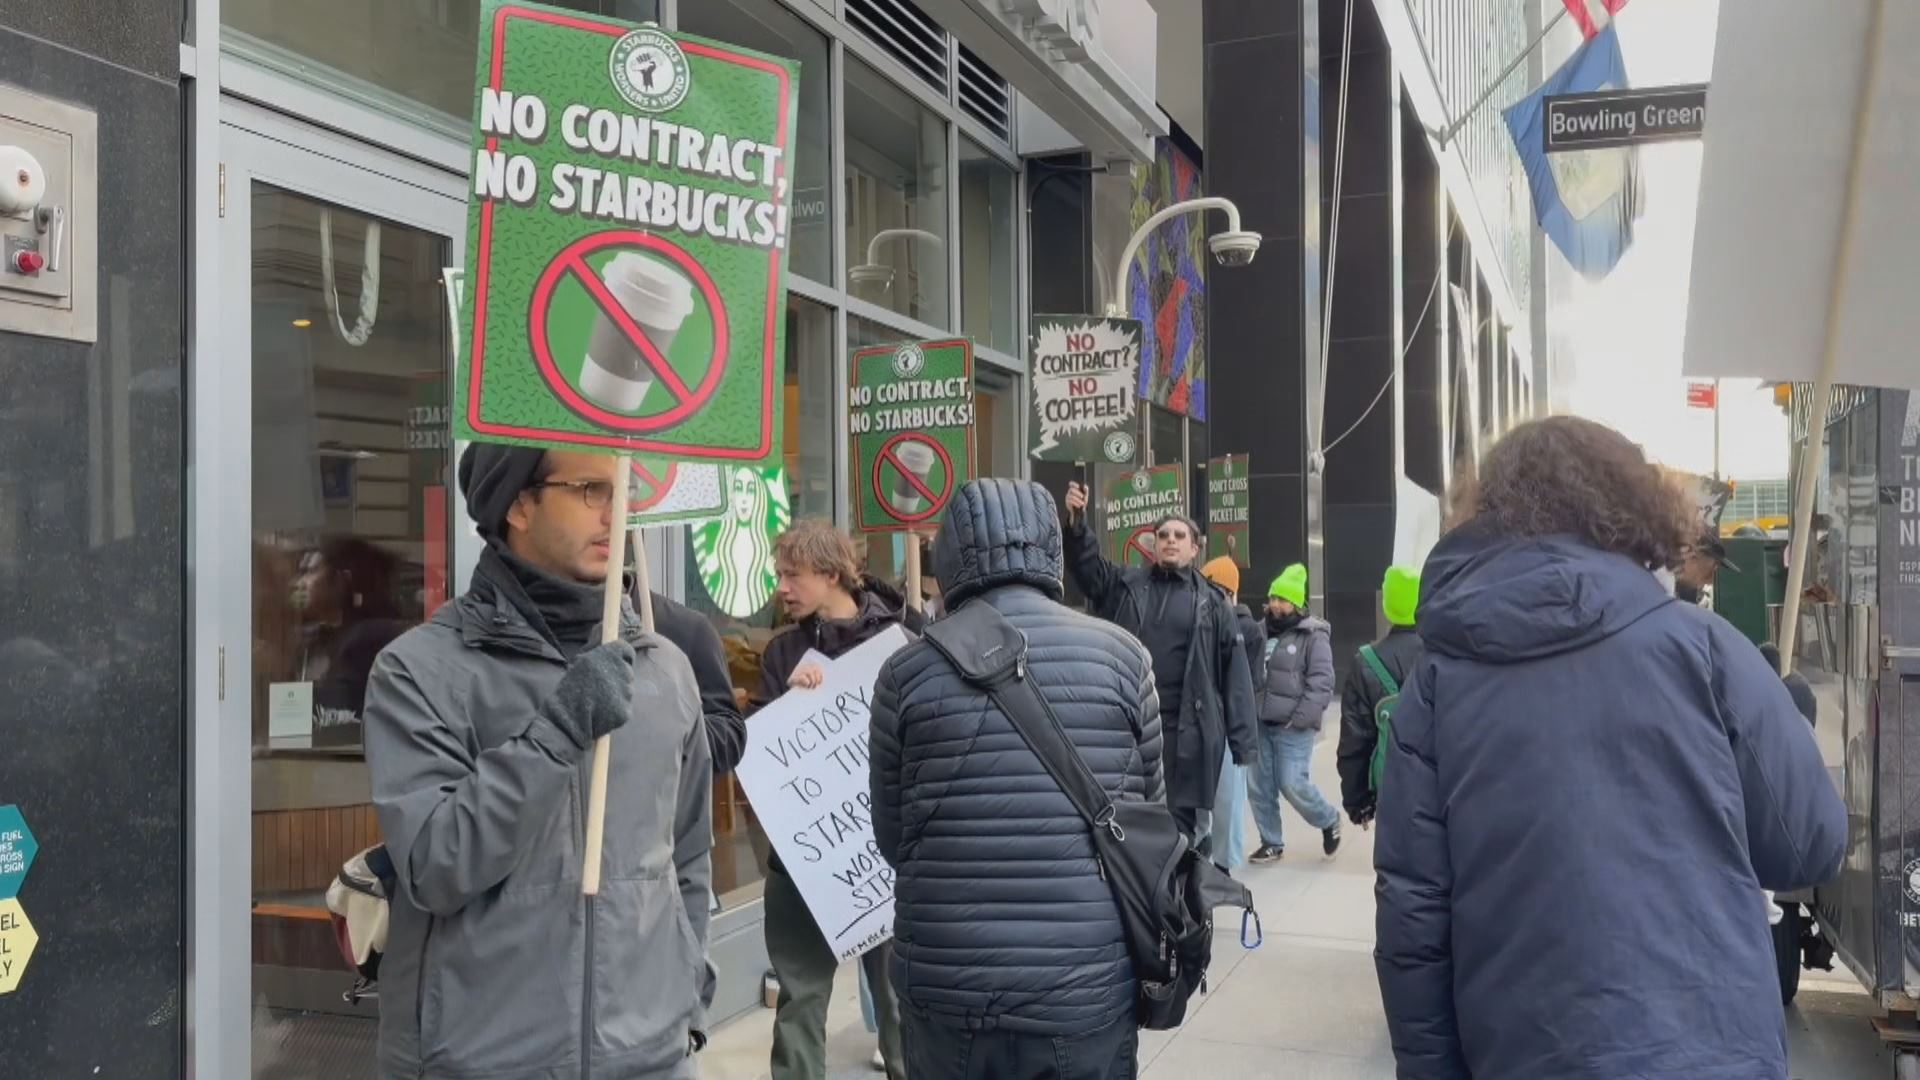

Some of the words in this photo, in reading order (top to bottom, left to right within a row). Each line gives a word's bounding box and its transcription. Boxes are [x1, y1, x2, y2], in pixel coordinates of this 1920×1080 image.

[622, 34, 680, 62] STARBUCKS
[1552, 109, 1636, 135] Bowling
[1643, 104, 1705, 127] Green
[480, 87, 546, 139] NO
[561, 104, 787, 198] CONTRACT,
[475, 149, 537, 202] NO
[550, 163, 787, 248] STARBUCKS!
[1066, 333, 1095, 352] NO
[1041, 346, 1130, 374] CONTRACT?
[850, 386, 872, 407] NO
[876, 377, 972, 403] CONTRACT,
[1068, 377, 1097, 396] NO
[850, 411, 871, 433] NO
[875, 403, 973, 431] STARBUCKS!
[1045, 387, 1126, 422] COFFEE!
[1107, 499, 1121, 514] NO
[1123, 489, 1183, 510] CONTRACT,
[1107, 516, 1121, 531] NO
[765, 686, 872, 768] VICTORY
[780, 777, 822, 806] TO
[2, 830, 23, 841] FUEL
[4, 861, 24, 873] SIGN
[852, 868, 896, 909] STR
[0, 912, 21, 931] EL
